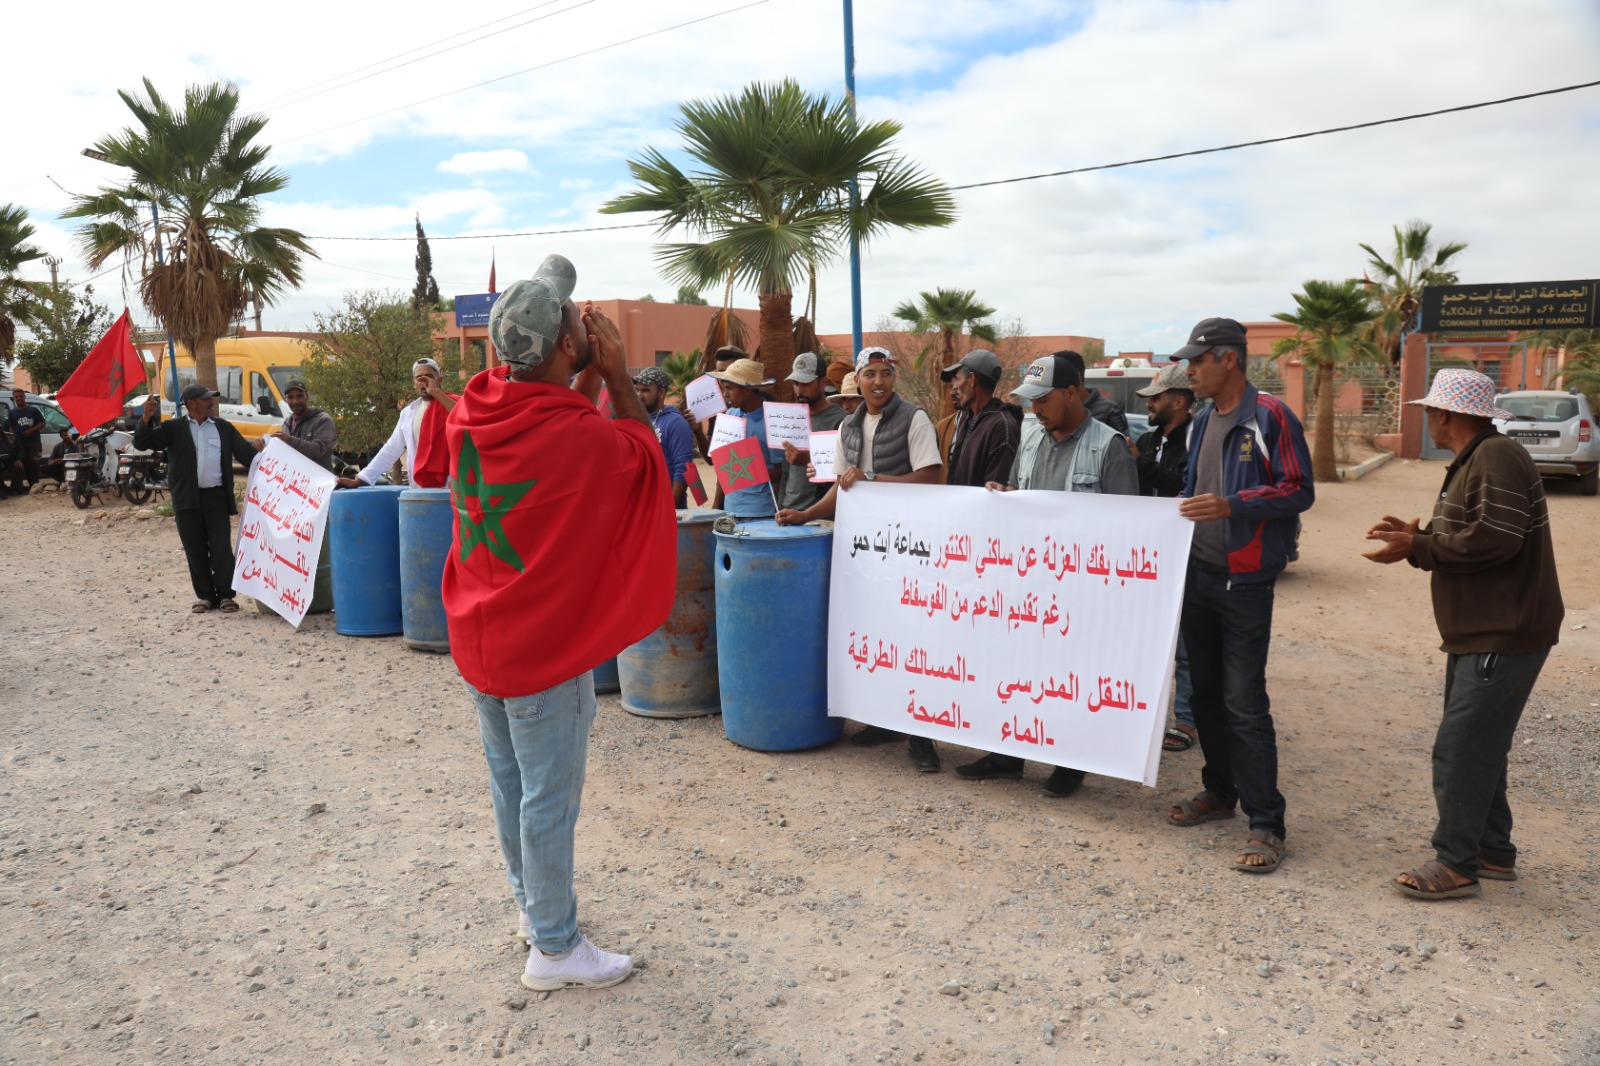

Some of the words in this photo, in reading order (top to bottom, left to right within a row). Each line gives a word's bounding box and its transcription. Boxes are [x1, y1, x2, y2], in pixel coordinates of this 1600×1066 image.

[1441, 293, 1467, 305] حمو
[1494, 288, 1537, 302] الترابية
[1539, 286, 1588, 300] الجماعة
[1439, 319, 1480, 327] COMMUNE
[1481, 318, 1531, 327] TERRITORIALE
[1532, 317, 1544, 326] AIT
[1545, 316, 1585, 325] HAMMOU
[850, 534, 870, 559] حمو
[894, 523, 931, 566] بجماعة
[934, 534, 971, 569] الكنتور
[976, 531, 1014, 579] ساكني
[1017, 546, 1038, 577] عن
[1043, 535, 1080, 581] العزلة
[241, 559, 262, 580] من
[1085, 544, 1111, 585] بفك
[1115, 546, 1158, 587] نطالب
[900, 576, 947, 618] الفوسفاط
[951, 591, 969, 621] من
[972, 590, 1003, 629] الدعم
[1007, 592, 1038, 634] تقديم
[1043, 593, 1070, 638] رغم
[848, 631, 898, 674] الطرقية
[997, 671, 1080, 704] المدرسي
